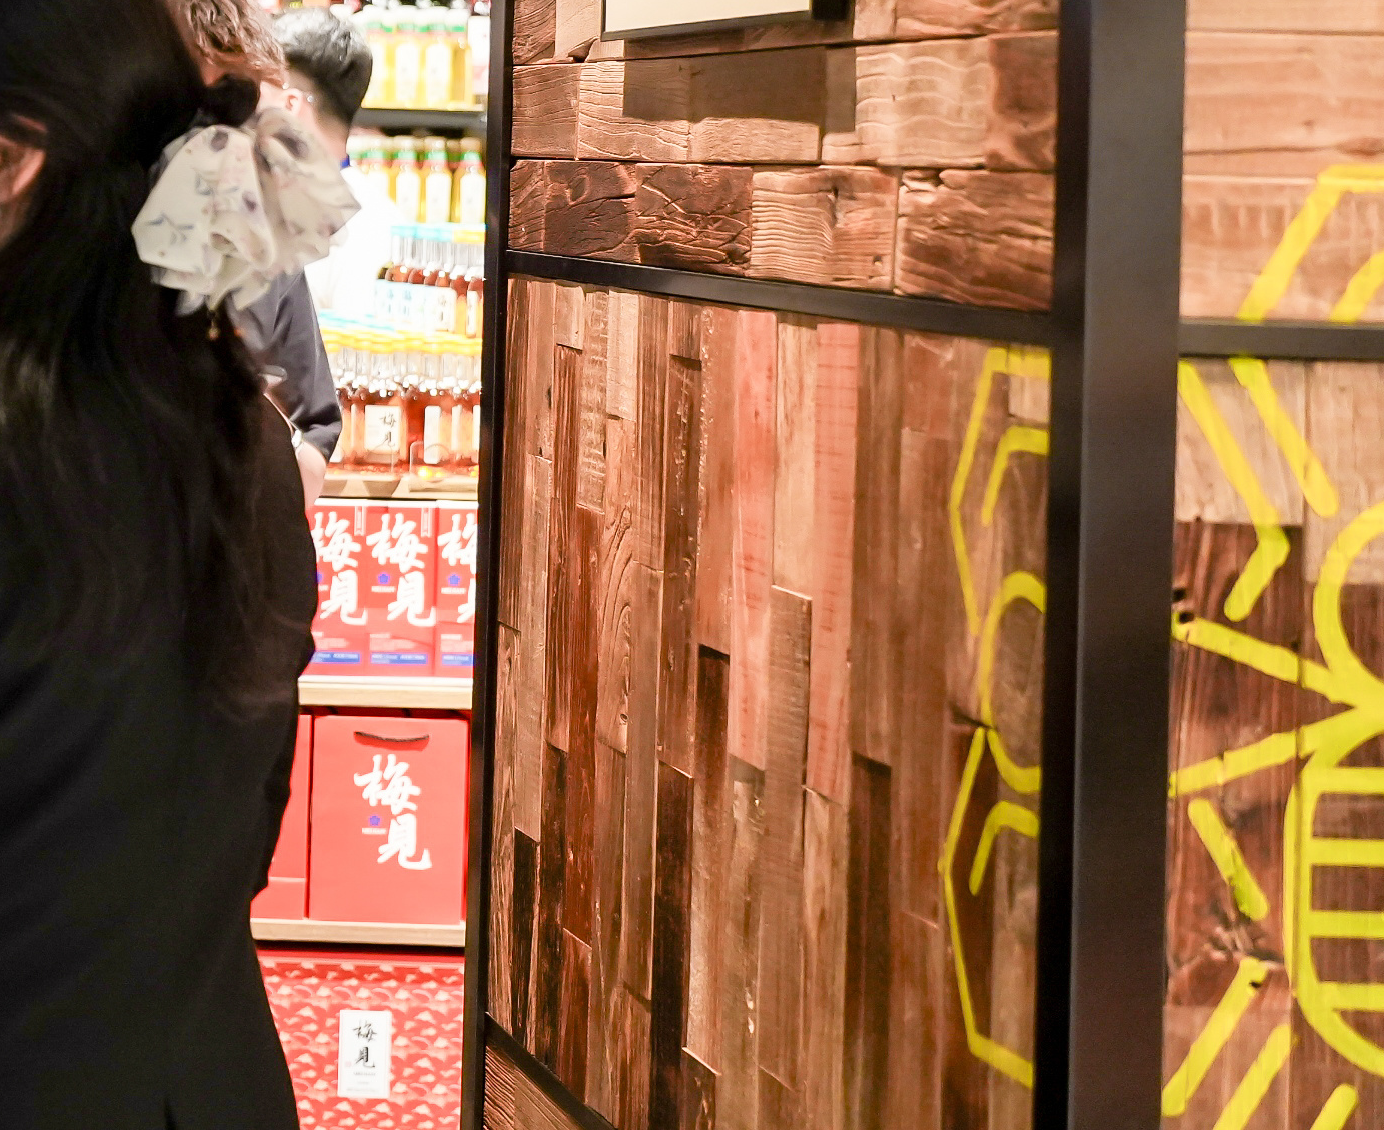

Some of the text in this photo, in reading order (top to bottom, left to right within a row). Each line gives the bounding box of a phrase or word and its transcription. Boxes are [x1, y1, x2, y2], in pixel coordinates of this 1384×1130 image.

[311, 511, 369, 626] 梅见
[366, 513, 437, 627] 梅见
[354, 754, 432, 870] 梅见
[352, 1019, 378, 1068] 梅见
